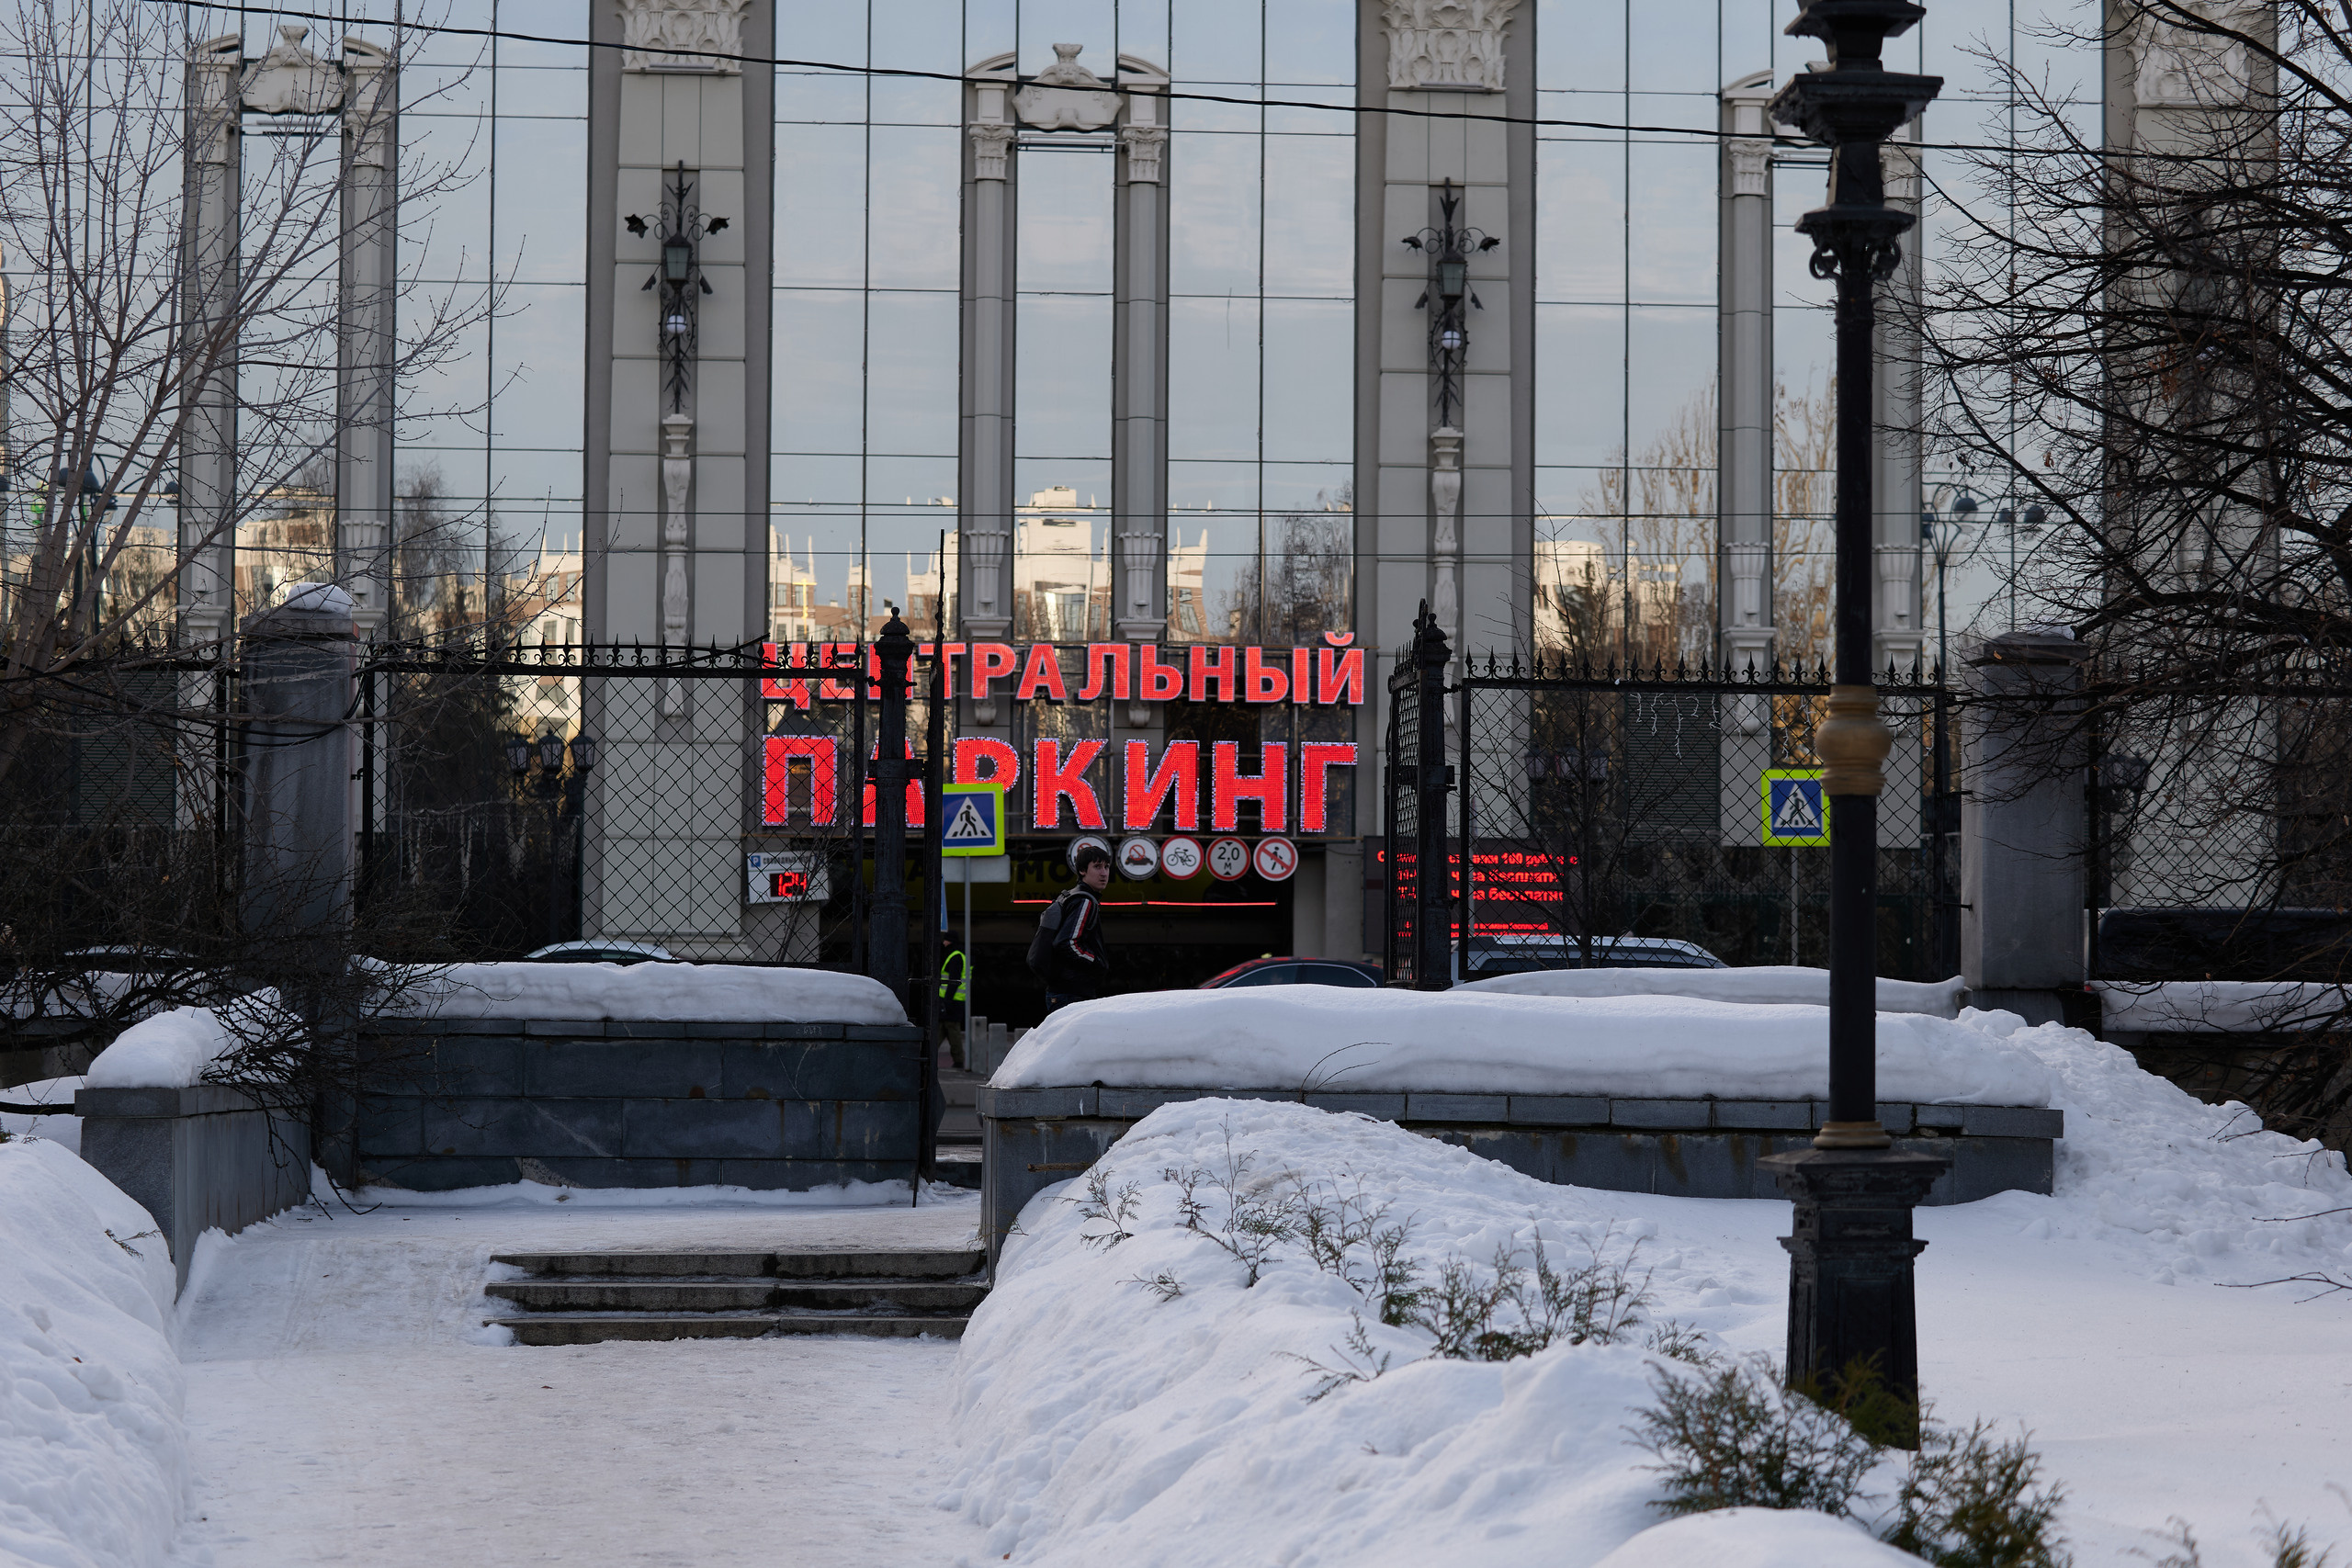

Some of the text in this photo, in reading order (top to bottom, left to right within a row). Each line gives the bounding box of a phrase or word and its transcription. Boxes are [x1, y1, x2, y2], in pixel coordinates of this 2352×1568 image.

[1217, 846, 1240, 862] 2,0
[1501, 852, 1523, 864] 100
[1488, 869, 1565, 883] бесплатн
[778, 872, 807, 897] 124
